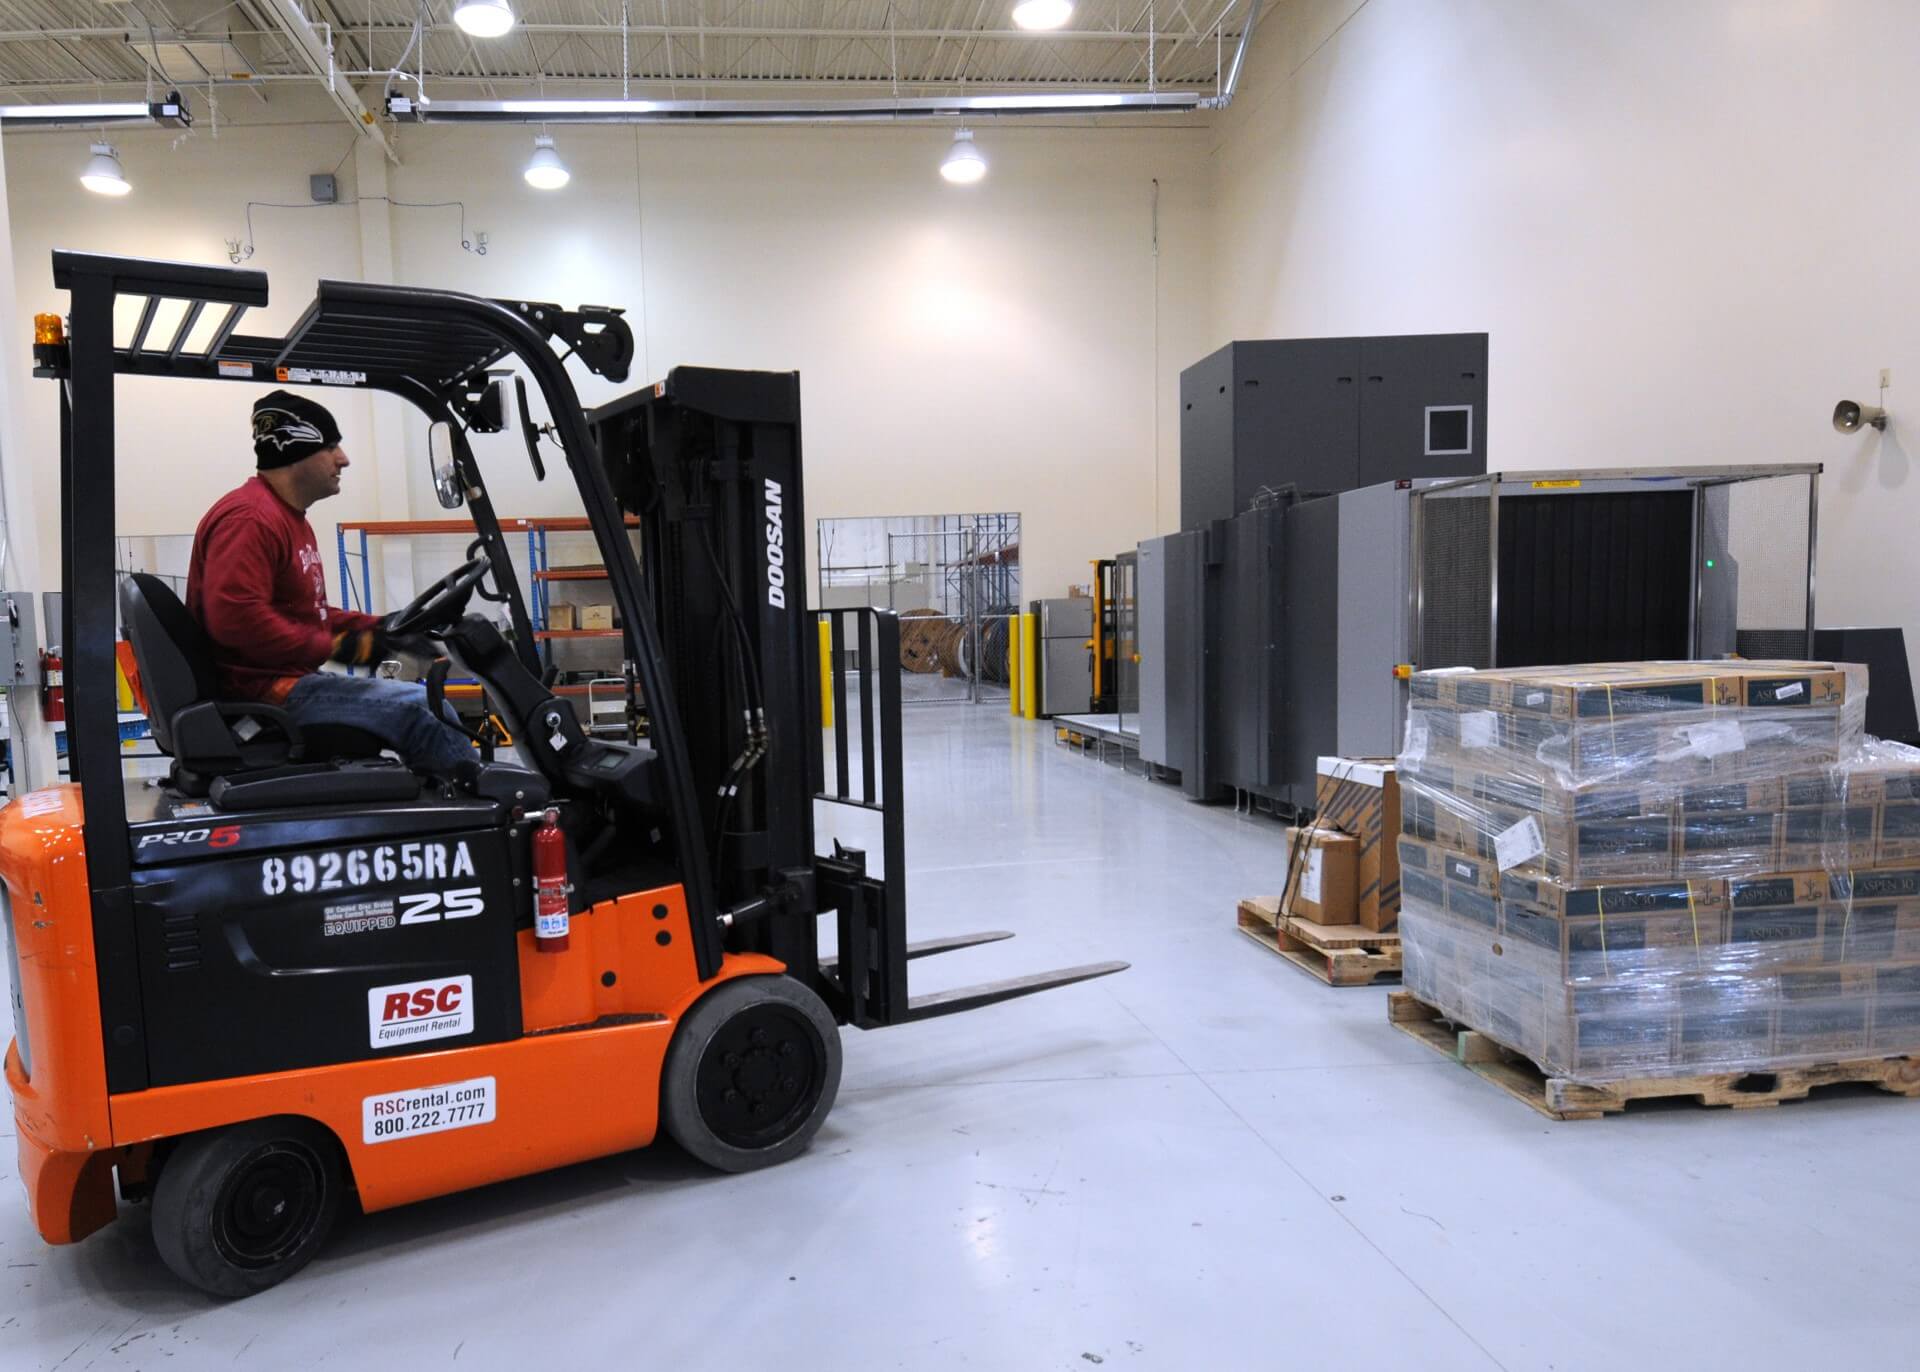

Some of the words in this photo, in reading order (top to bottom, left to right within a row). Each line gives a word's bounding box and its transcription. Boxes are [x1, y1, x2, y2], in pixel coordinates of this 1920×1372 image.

[765, 478, 785, 609] DOOSAN
[262, 841, 475, 895] 892665RA
[399, 887, 485, 925] 25
[324, 915, 396, 936] EQUIPPED
[382, 984, 463, 1021] RSC
[379, 1022, 429, 1039] Equipment
[431, 1017, 461, 1031] Rental
[374, 1087, 485, 1117] RSCrental.com
[375, 1103, 485, 1136] 800.222.7777
